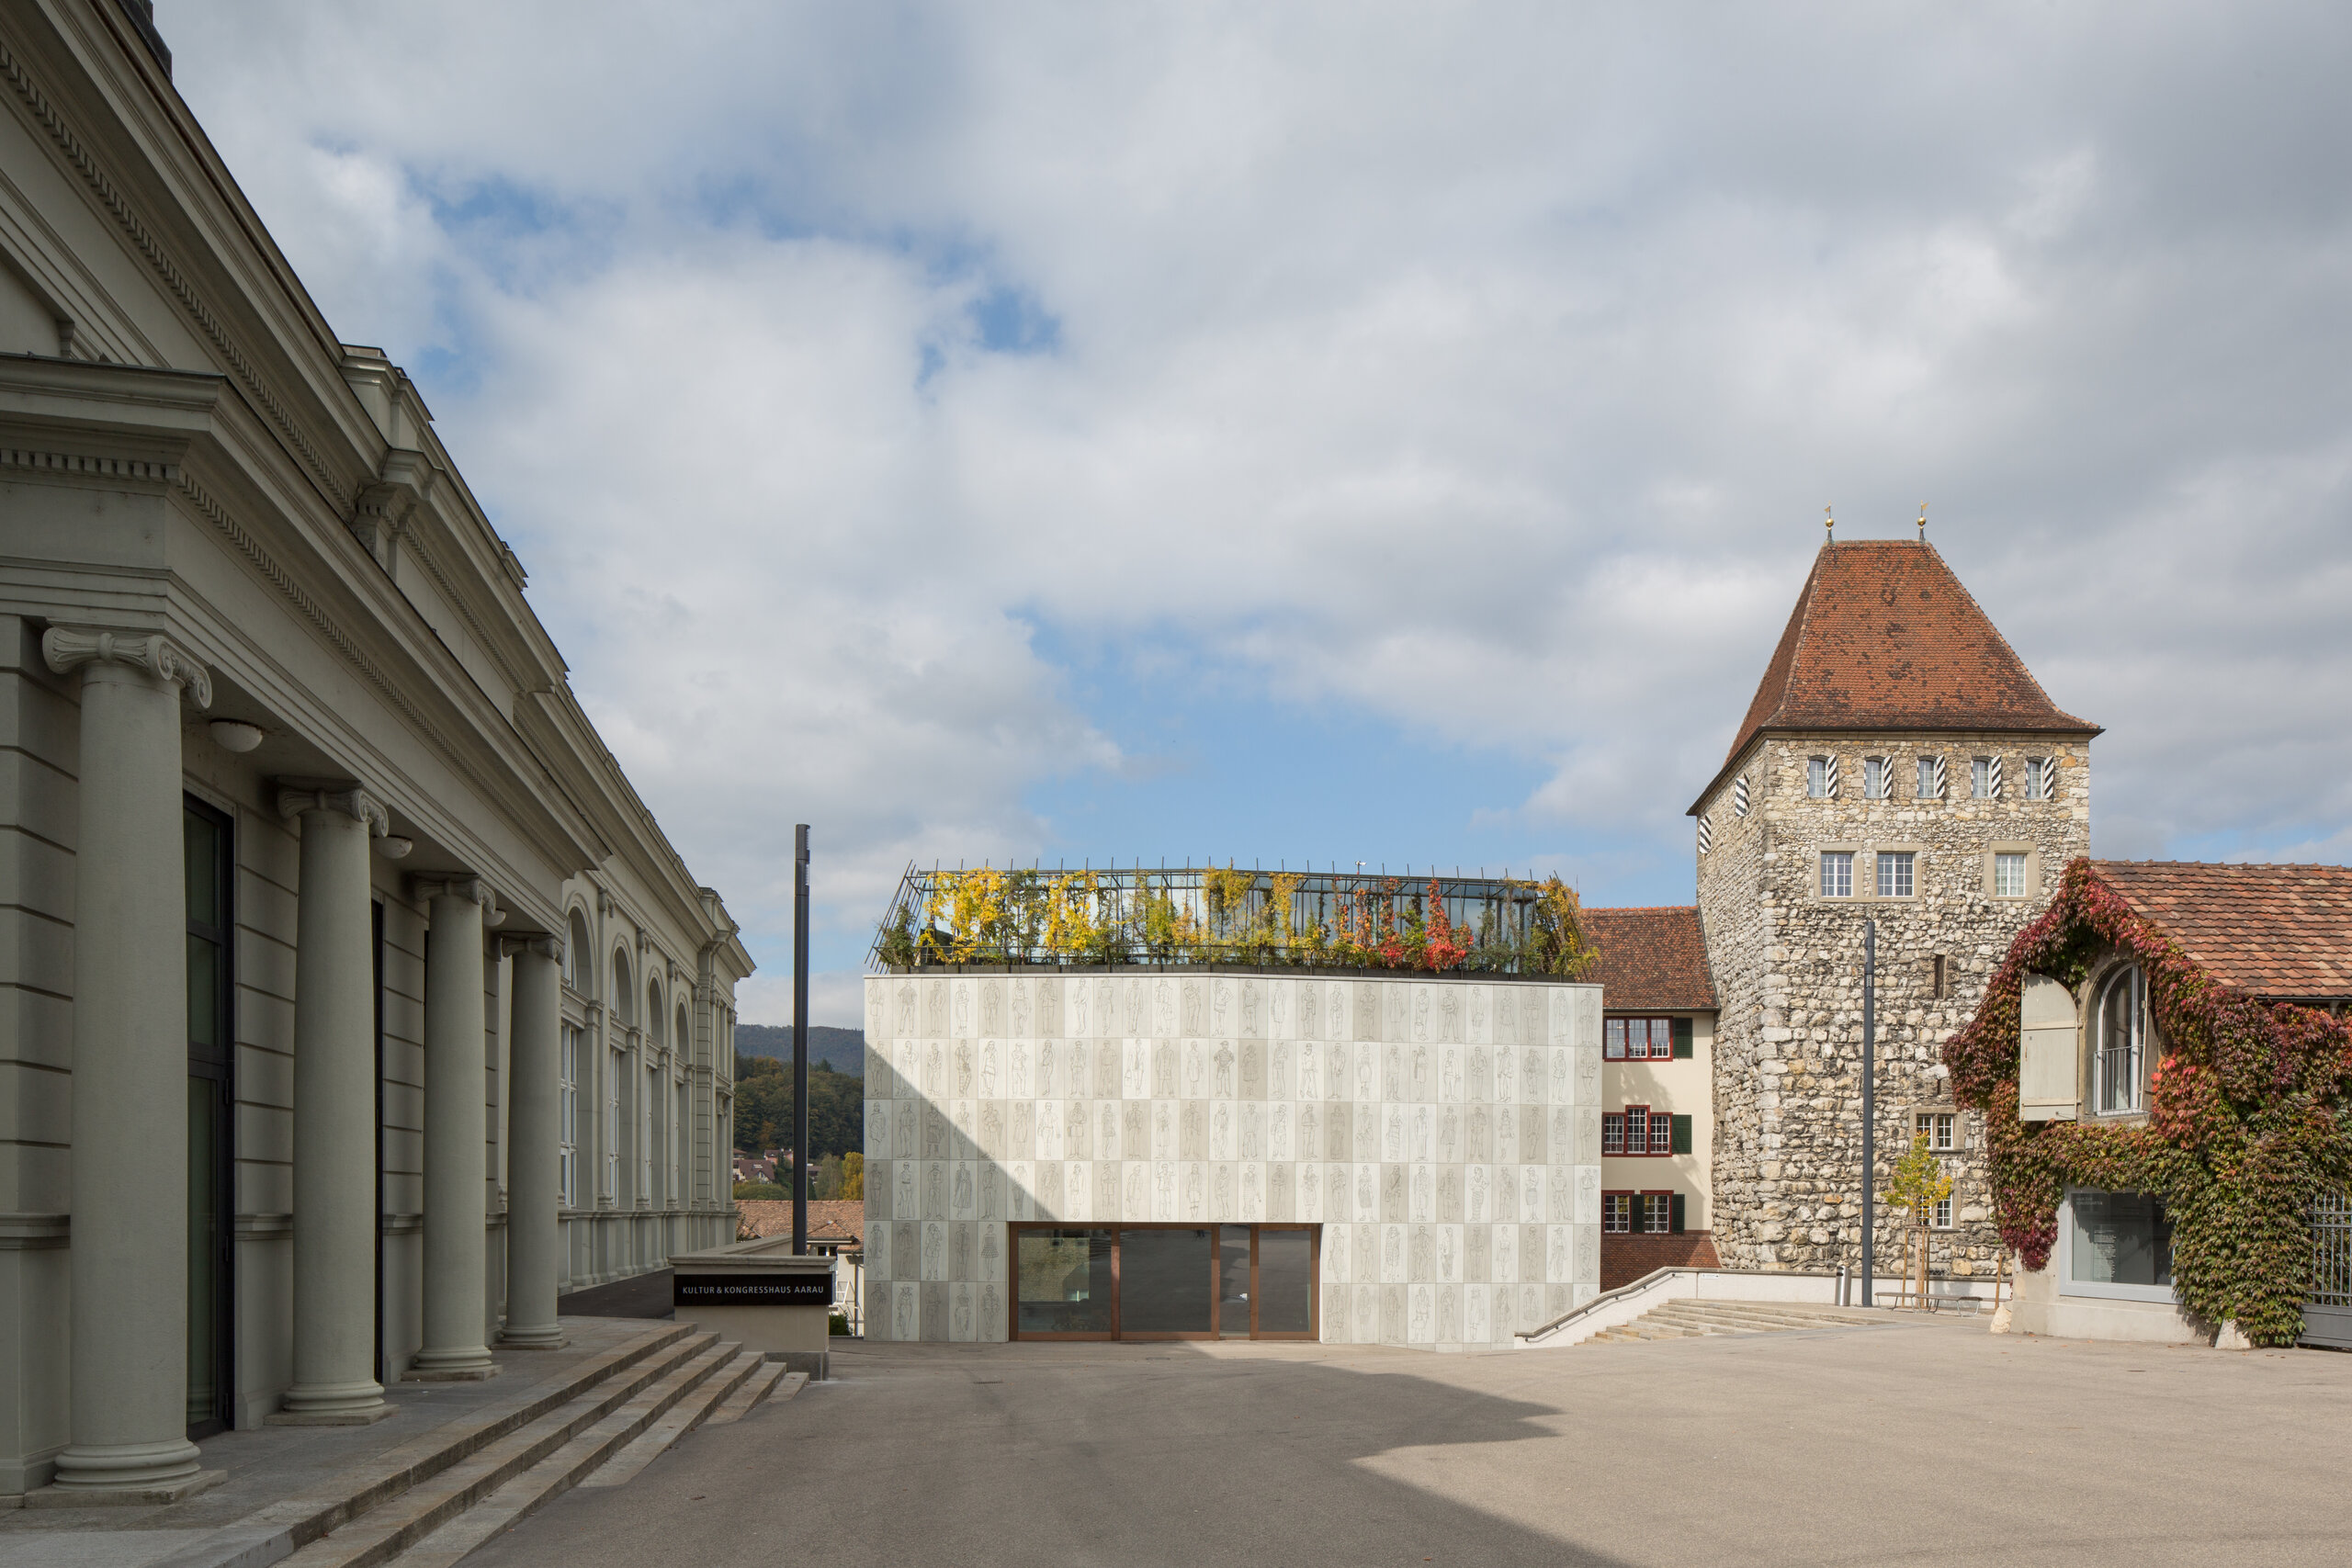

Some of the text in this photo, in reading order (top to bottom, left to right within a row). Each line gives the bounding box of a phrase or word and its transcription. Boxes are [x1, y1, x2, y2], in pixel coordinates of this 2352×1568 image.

[683, 1286, 715, 1294] KULTUR
[717, 1286, 722, 1294] &
[724, 1286, 791, 1294] KONGRESSHAUS
